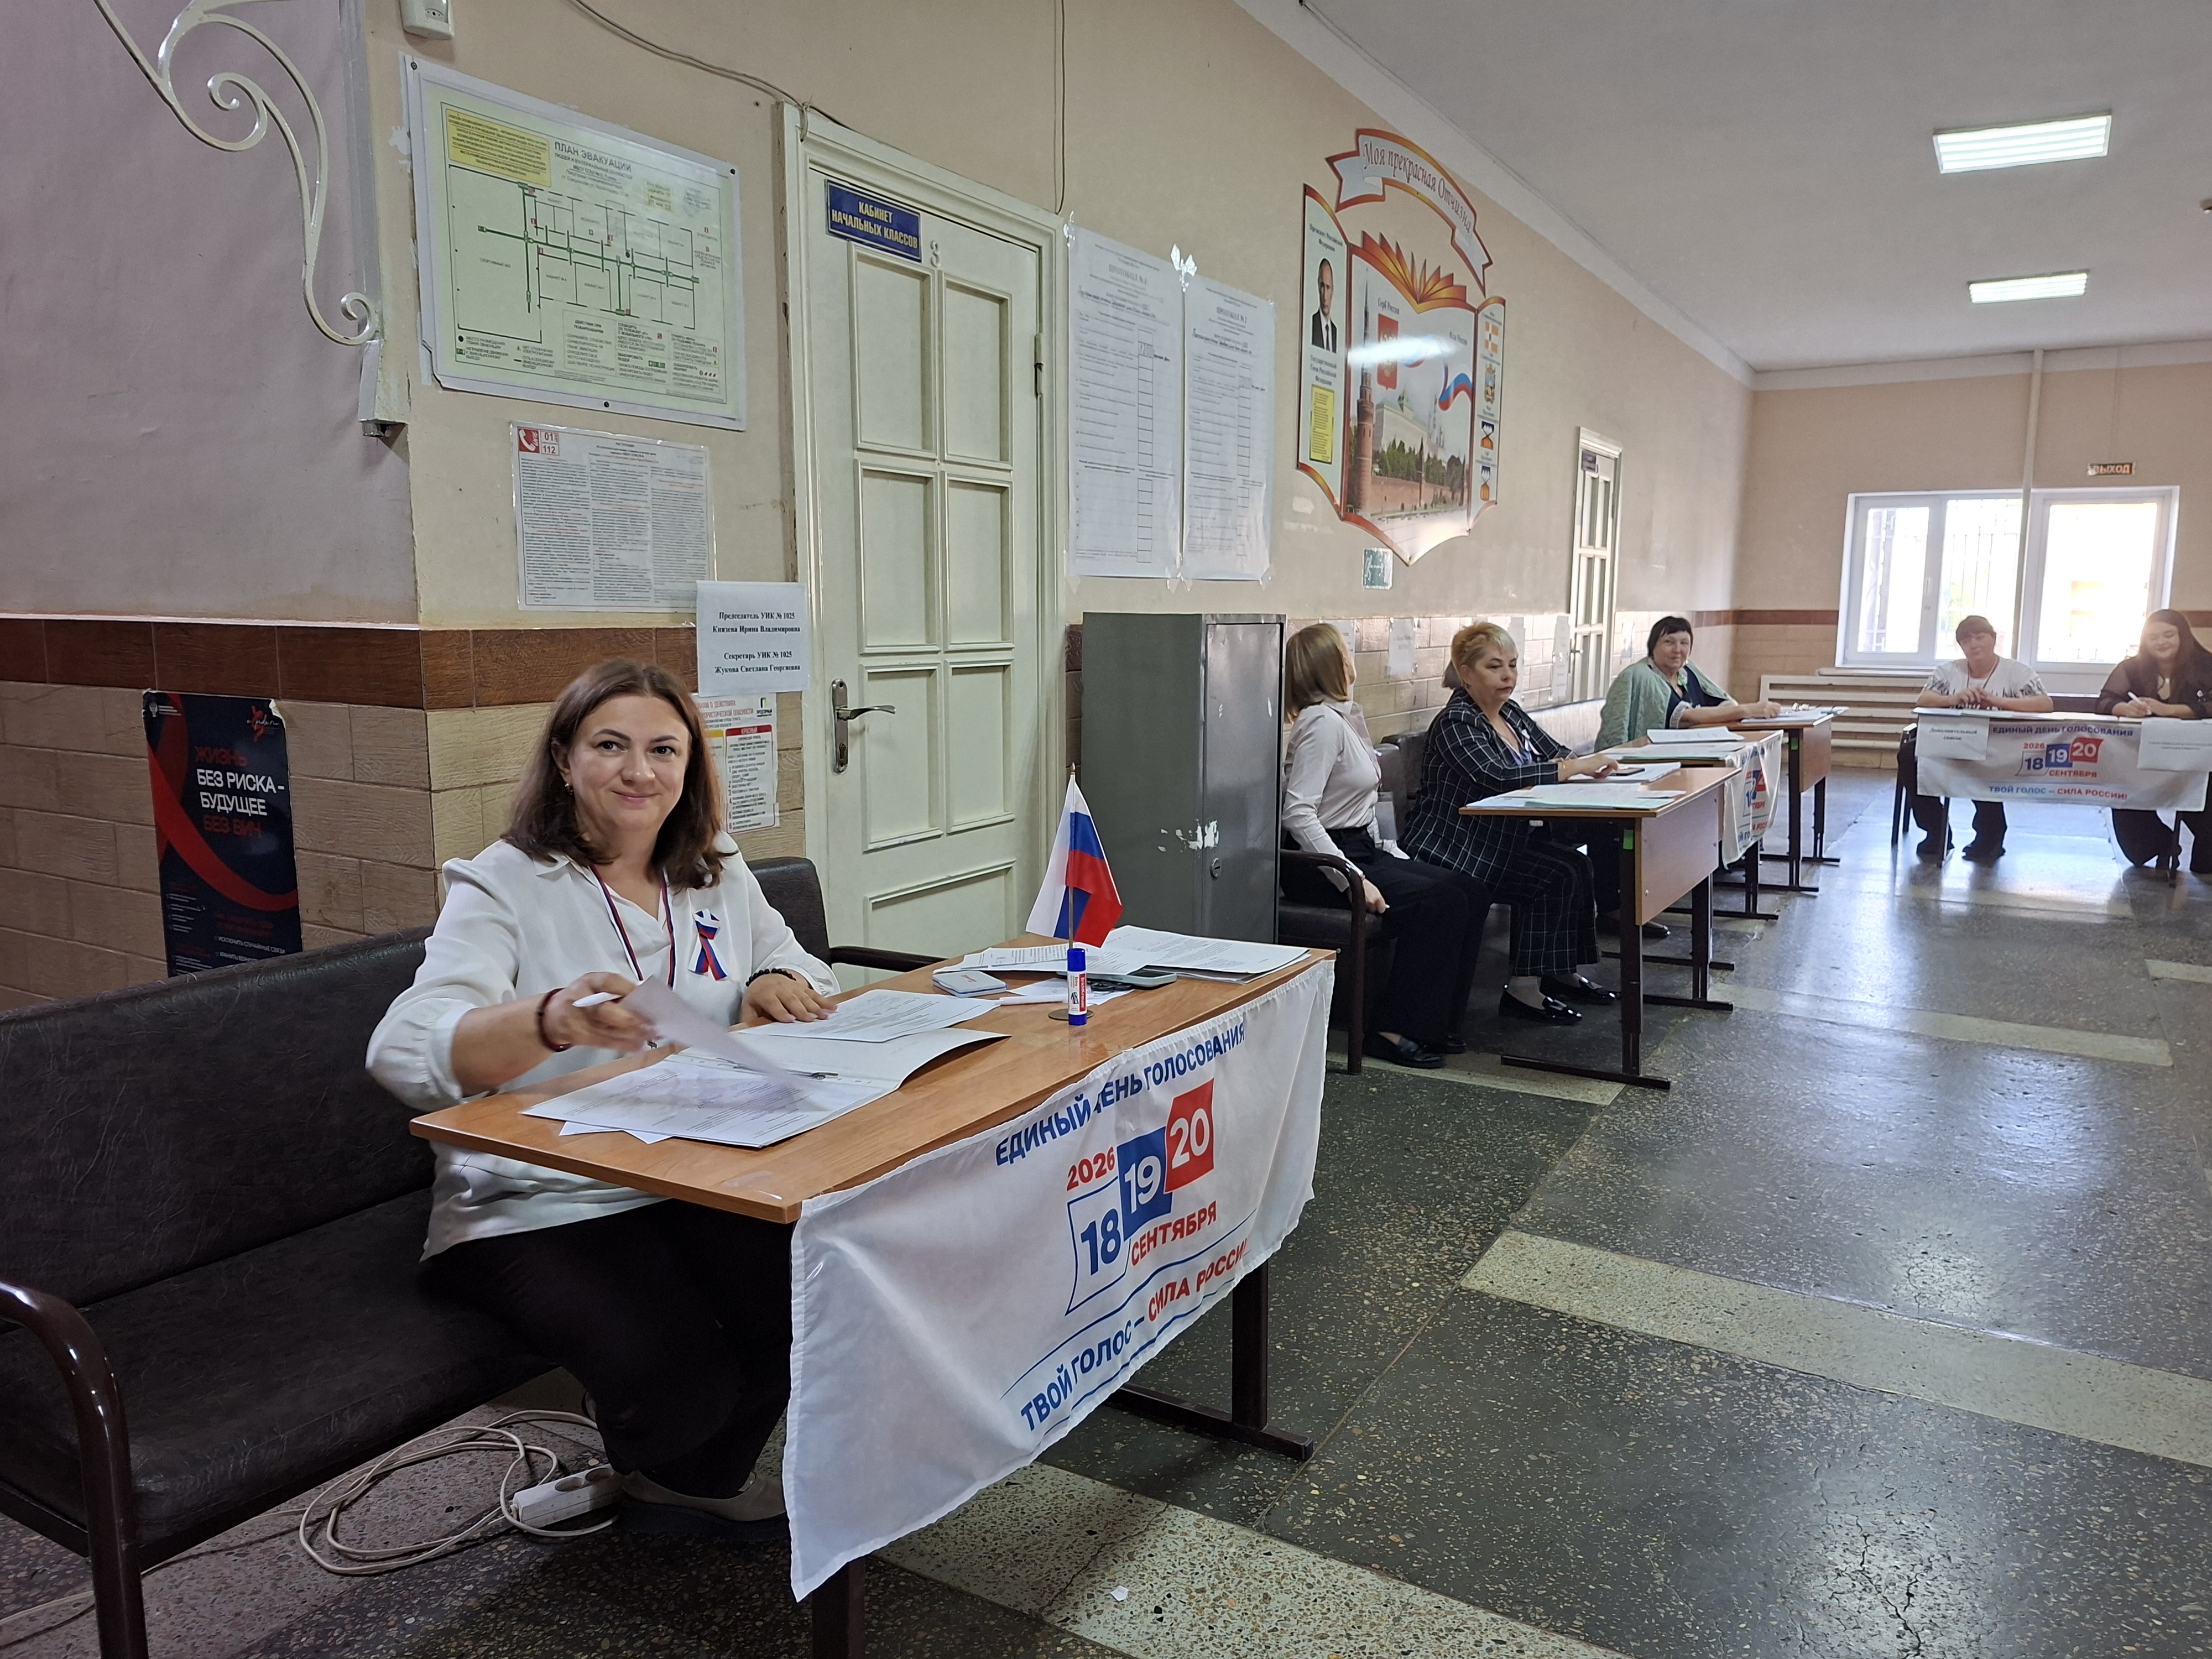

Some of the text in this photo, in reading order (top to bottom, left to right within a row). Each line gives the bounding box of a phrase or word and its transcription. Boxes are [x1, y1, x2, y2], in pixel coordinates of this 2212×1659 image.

[555, 142, 578, 156] ПЛАН
[581, 150, 632, 172] ЭВАКУАЦИИ
[1363, 141, 1471, 233] Моя прекрасная Отчизна
[859, 201, 893, 223] КАБИНЕТ
[832, 209, 918, 248] НАЧАЛЬНЫХ КЛАССОВ
[544, 432, 553, 441] 01
[542, 445, 555, 454] 112
[719, 612, 759, 620] Председатель
[739, 625, 759, 634] Ирина
[760, 625, 801, 634] Владимировна
[724, 653, 755, 661] Секретарь
[714, 666, 739, 675] Жукова
[770, 664, 801, 673] Георгиевна
[1993, 726, 2033, 734] ЕДИНЫЙ
[2062, 725, 2133, 736] ГОЛОСОВАНИЯ
[195, 747, 248, 766] ЖИЗНЬ
[2025, 742, 2096, 770] 18 19 20
[197, 769, 223, 787] БЕЗ
[226, 772, 276, 794] РИСКА
[2049, 769, 2097, 778] СЕНТЯБРЯ
[200, 791, 268, 817] БУДУЩЕЕ
[1989, 785, 2013, 794] ТВОЙ
[2085, 789, 2128, 800] РОССИИ!
[996, 1093, 1092, 1166] ЕДИНЫЙ
[1144, 1022, 1245, 1091] ГОЛОСОВАНИЯ
[1067, 1146, 1115, 1192] 2026
[1081, 1108, 1210, 1276] 18 19 20
[1131, 1200, 1216, 1266] СЕНТЯБРЯ
[1021, 1364, 1073, 1432] ТВОЙ
[1071, 1319, 1131, 1384] ГОЛОС
[1148, 1277, 1190, 1322] СИЛА
[1196, 1237, 1248, 1293] РОССИ
